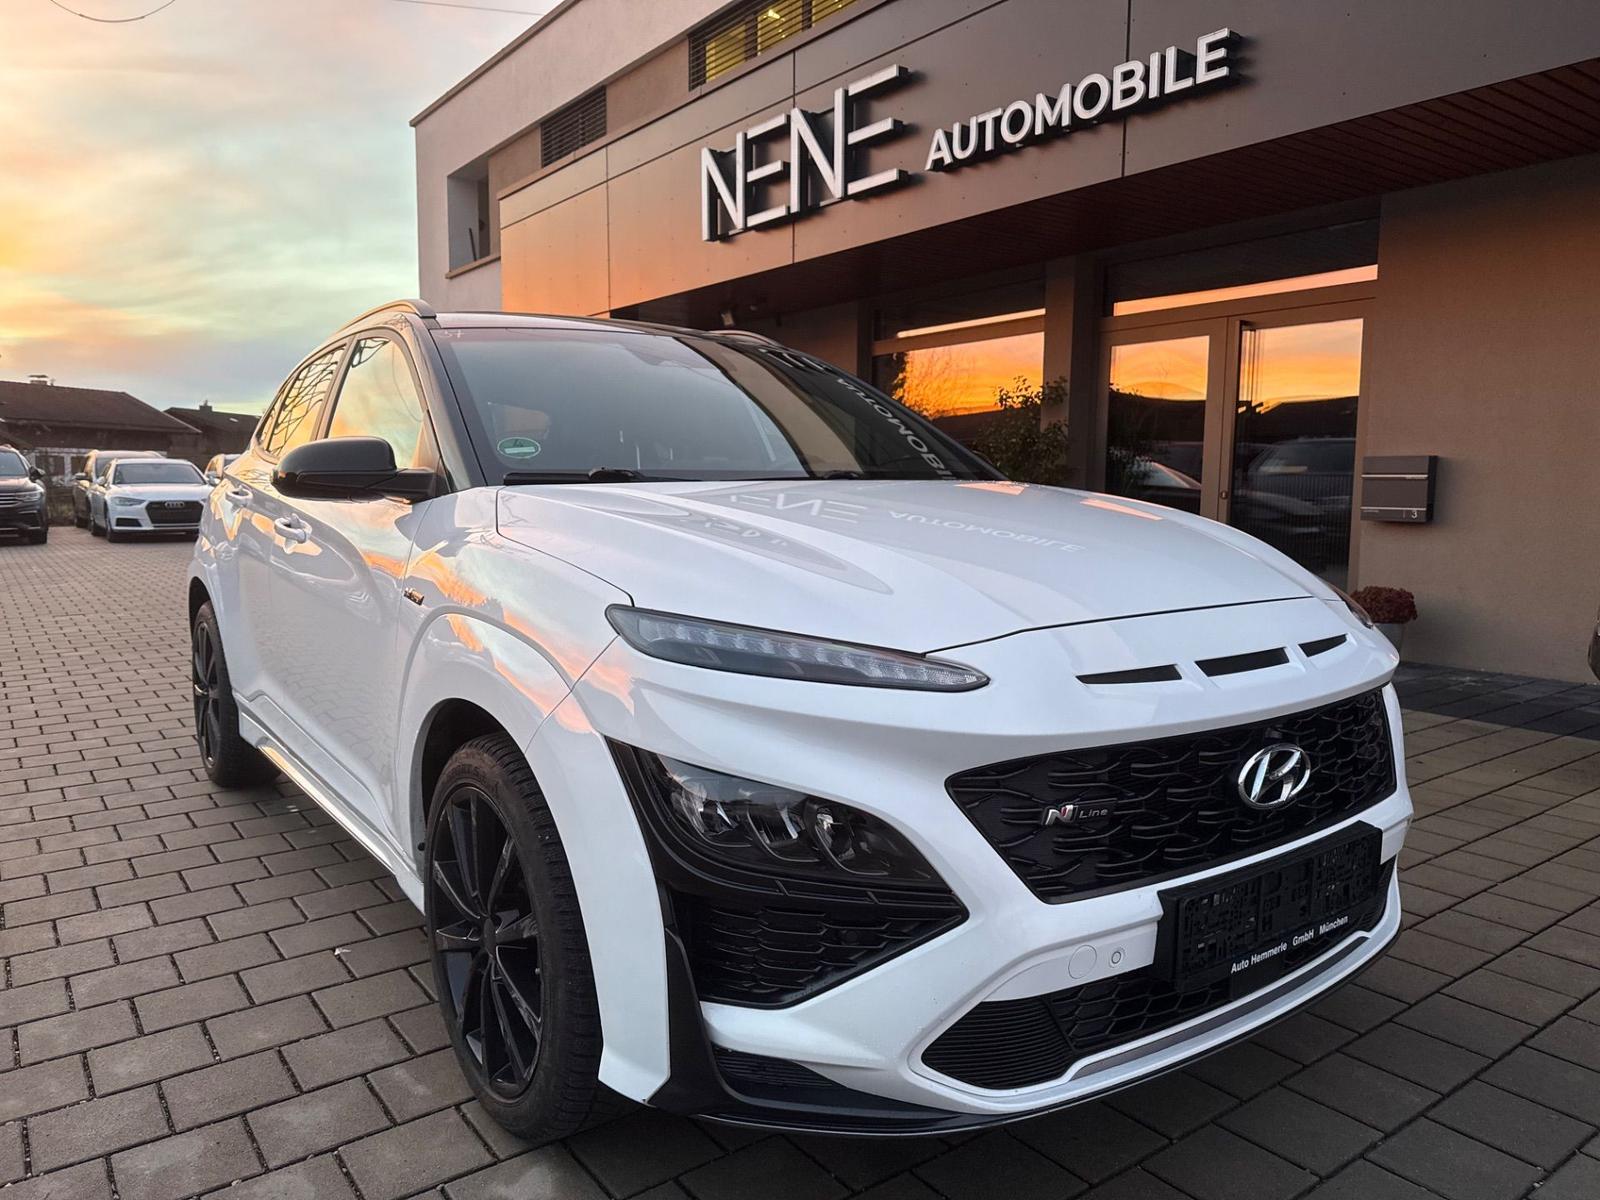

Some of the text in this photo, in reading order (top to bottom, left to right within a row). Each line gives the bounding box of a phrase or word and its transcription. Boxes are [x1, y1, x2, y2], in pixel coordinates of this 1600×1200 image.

[701, 28, 1231, 242] NENE AUTOMOBILE
[1411, 509, 1418, 519] 3
[1079, 808, 1109, 819] Line
[1230, 915, 1349, 974] Auto Hemmerle GmbH München
